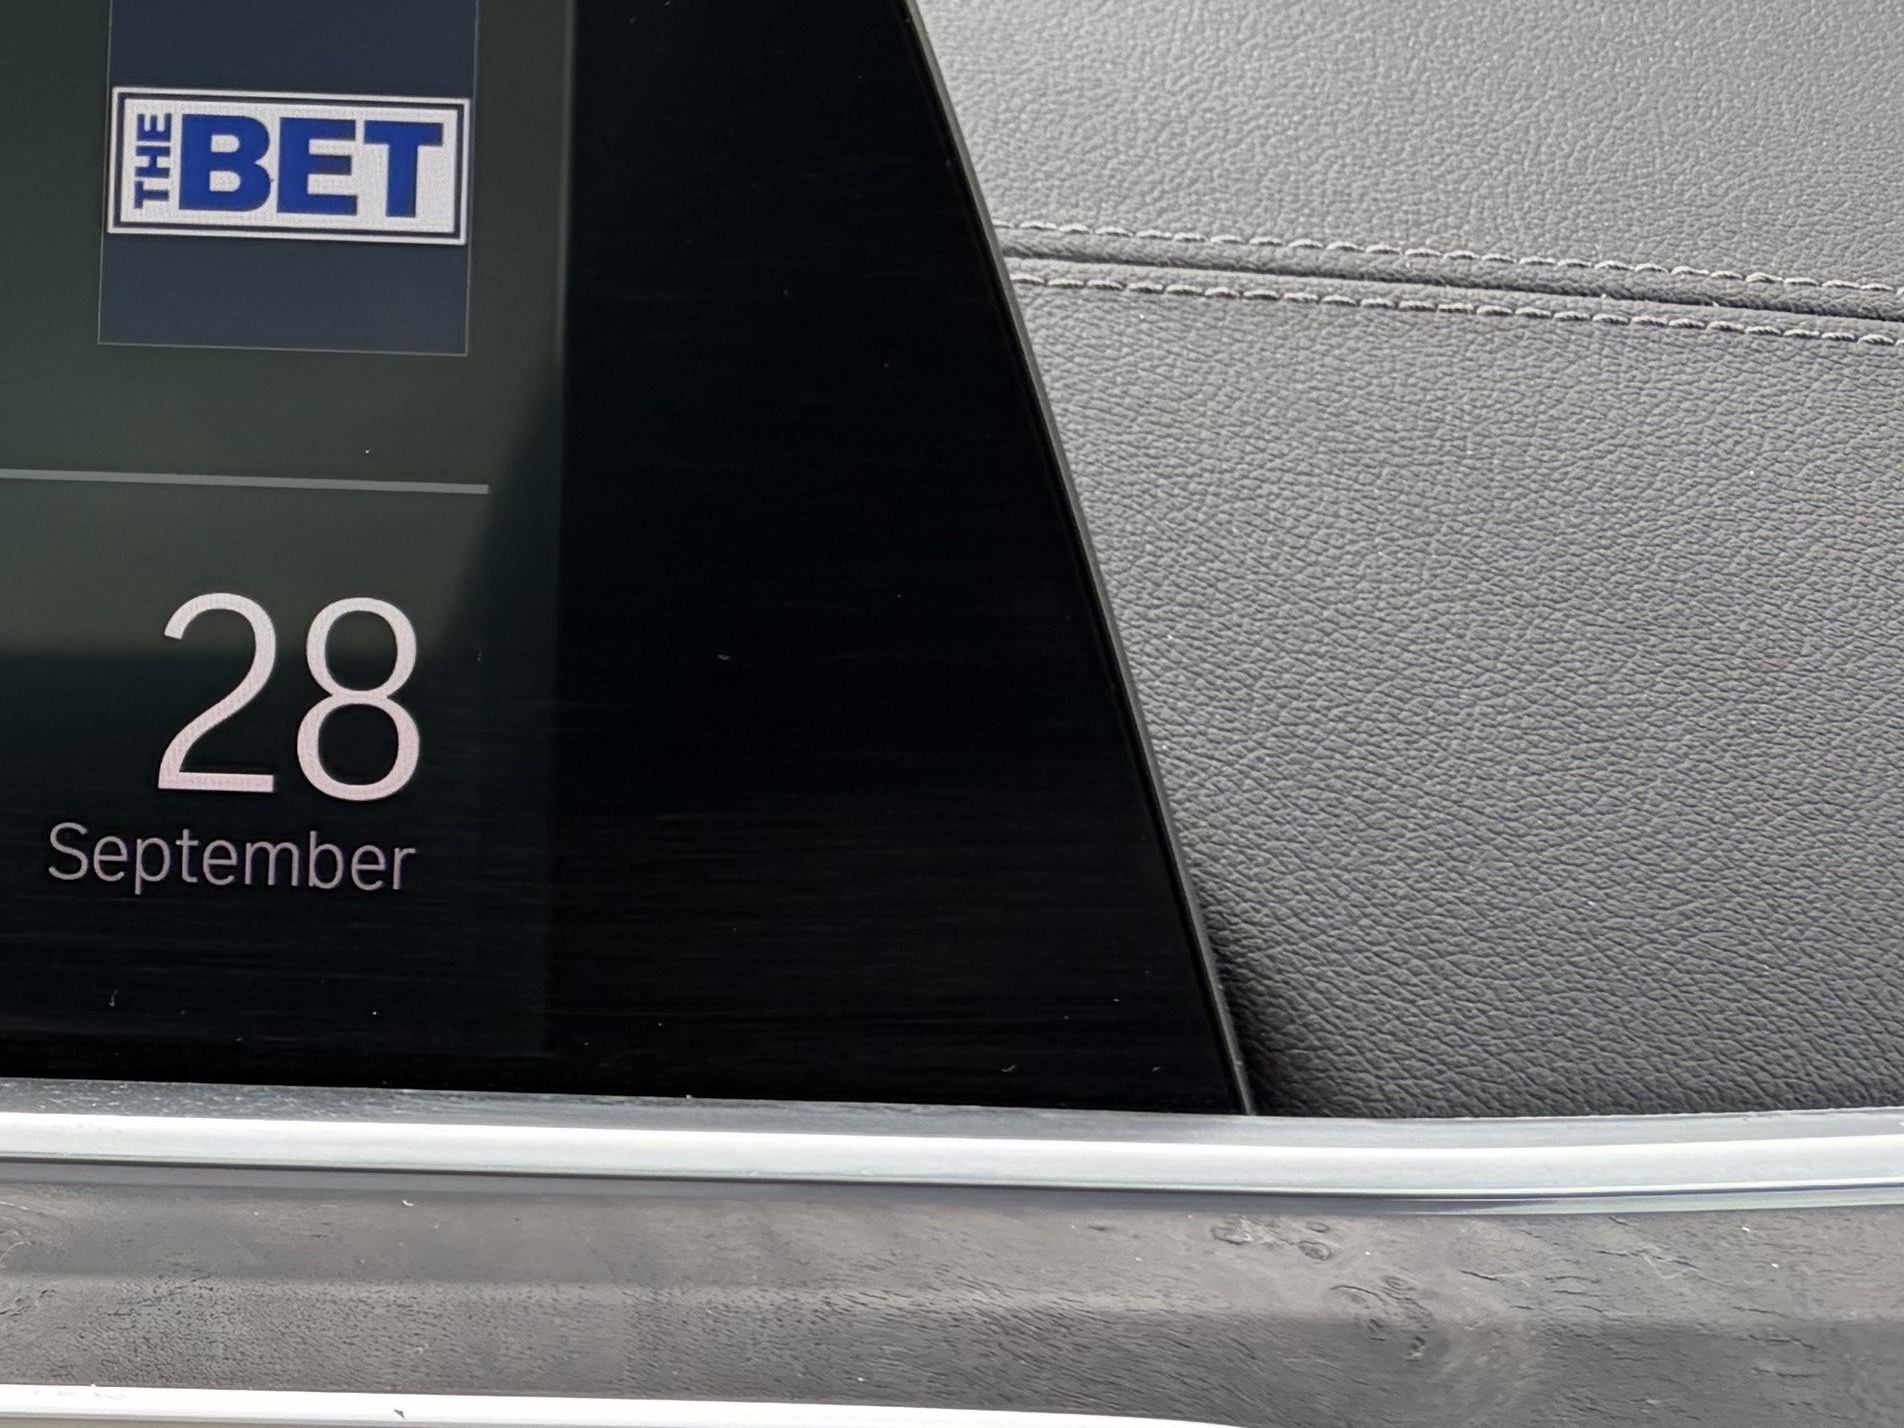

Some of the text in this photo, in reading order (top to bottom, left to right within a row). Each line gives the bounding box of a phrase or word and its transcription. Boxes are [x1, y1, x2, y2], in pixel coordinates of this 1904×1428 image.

[134, 112, 443, 218] THE BET
[157, 592, 421, 802] 28
[47, 821, 417, 896] September
